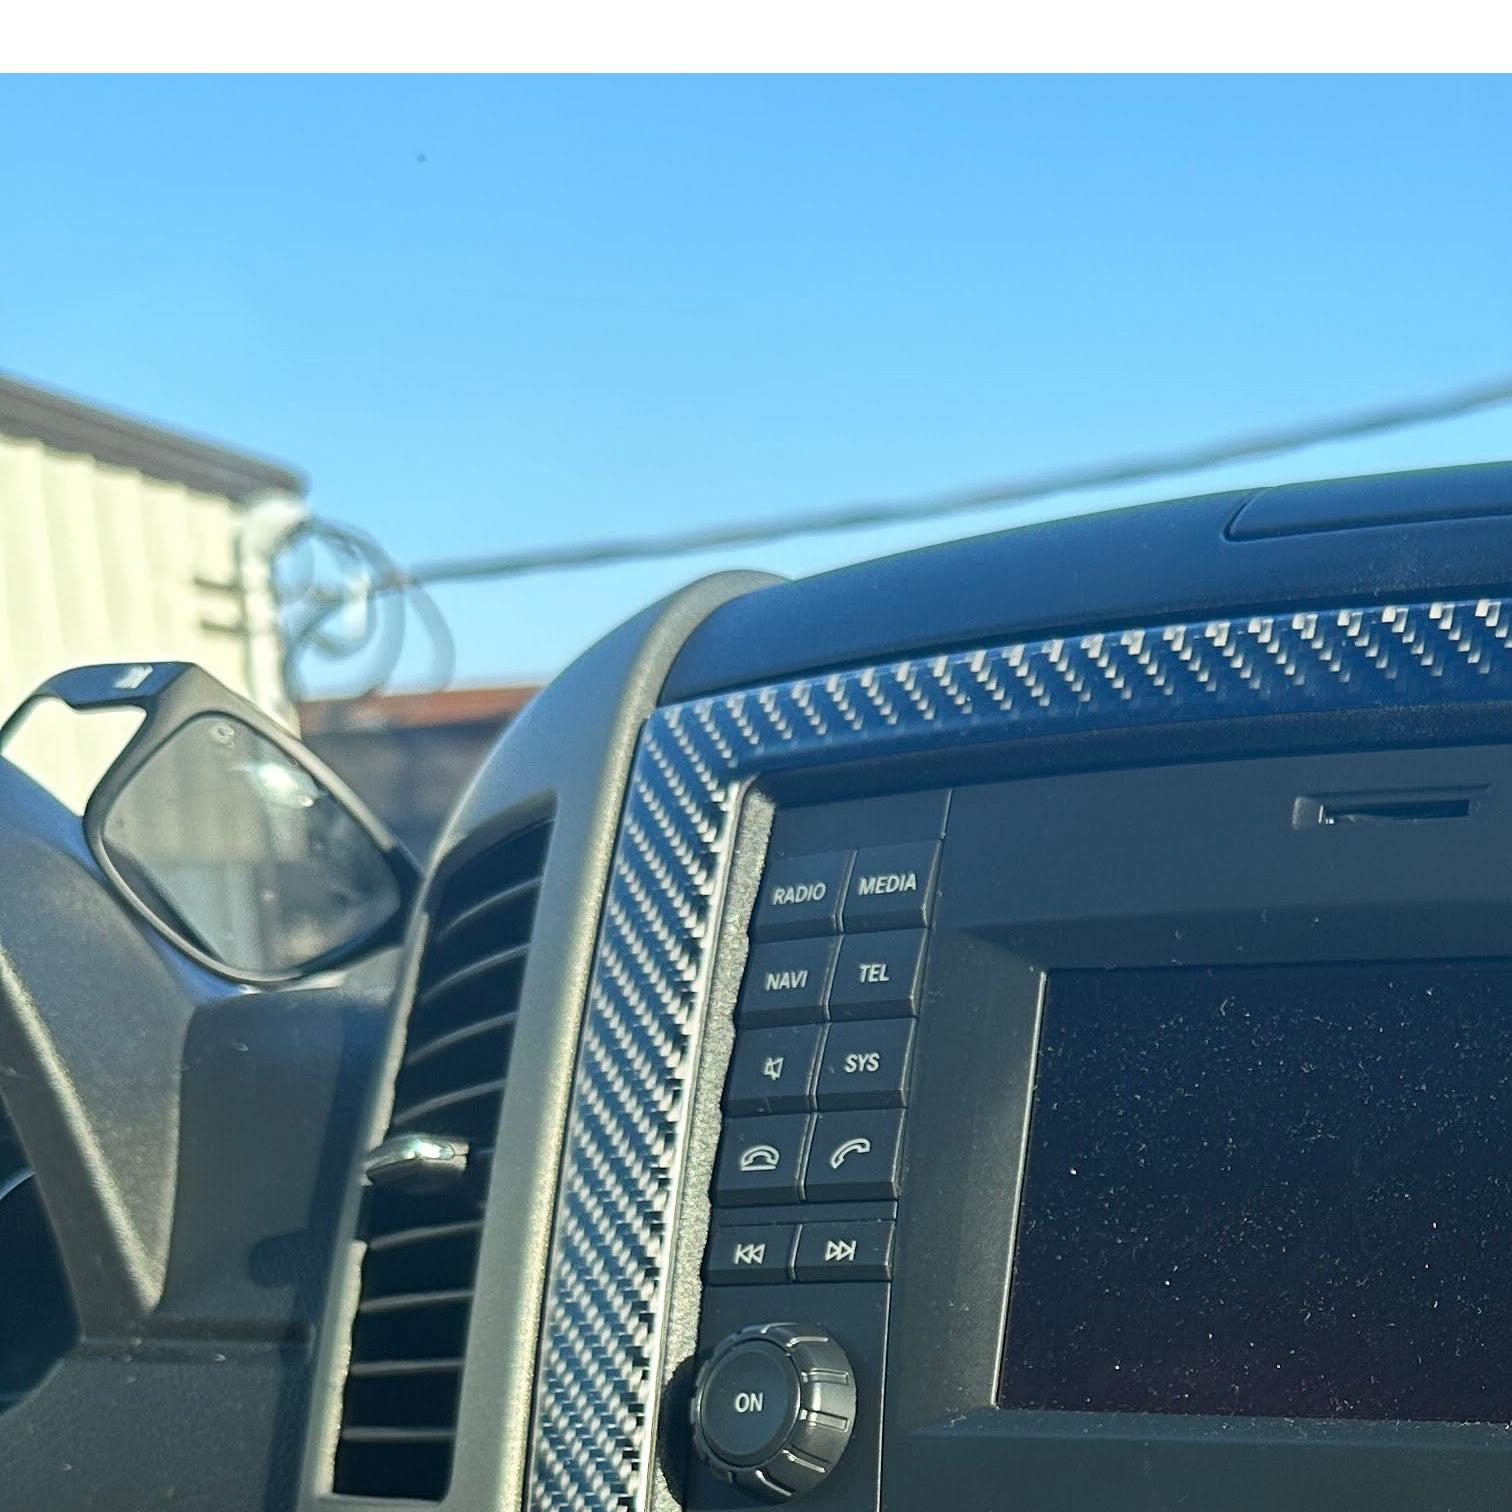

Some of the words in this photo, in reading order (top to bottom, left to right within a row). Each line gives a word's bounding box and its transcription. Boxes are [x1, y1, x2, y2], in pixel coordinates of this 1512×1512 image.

[772, 882, 826, 905] RADIO
[858, 873, 917, 896] MEDIA
[765, 970, 808, 991] NAVI
[859, 963, 889, 983] TEL
[844, 1052, 880, 1073] SYS
[734, 1392, 763, 1413] ON
